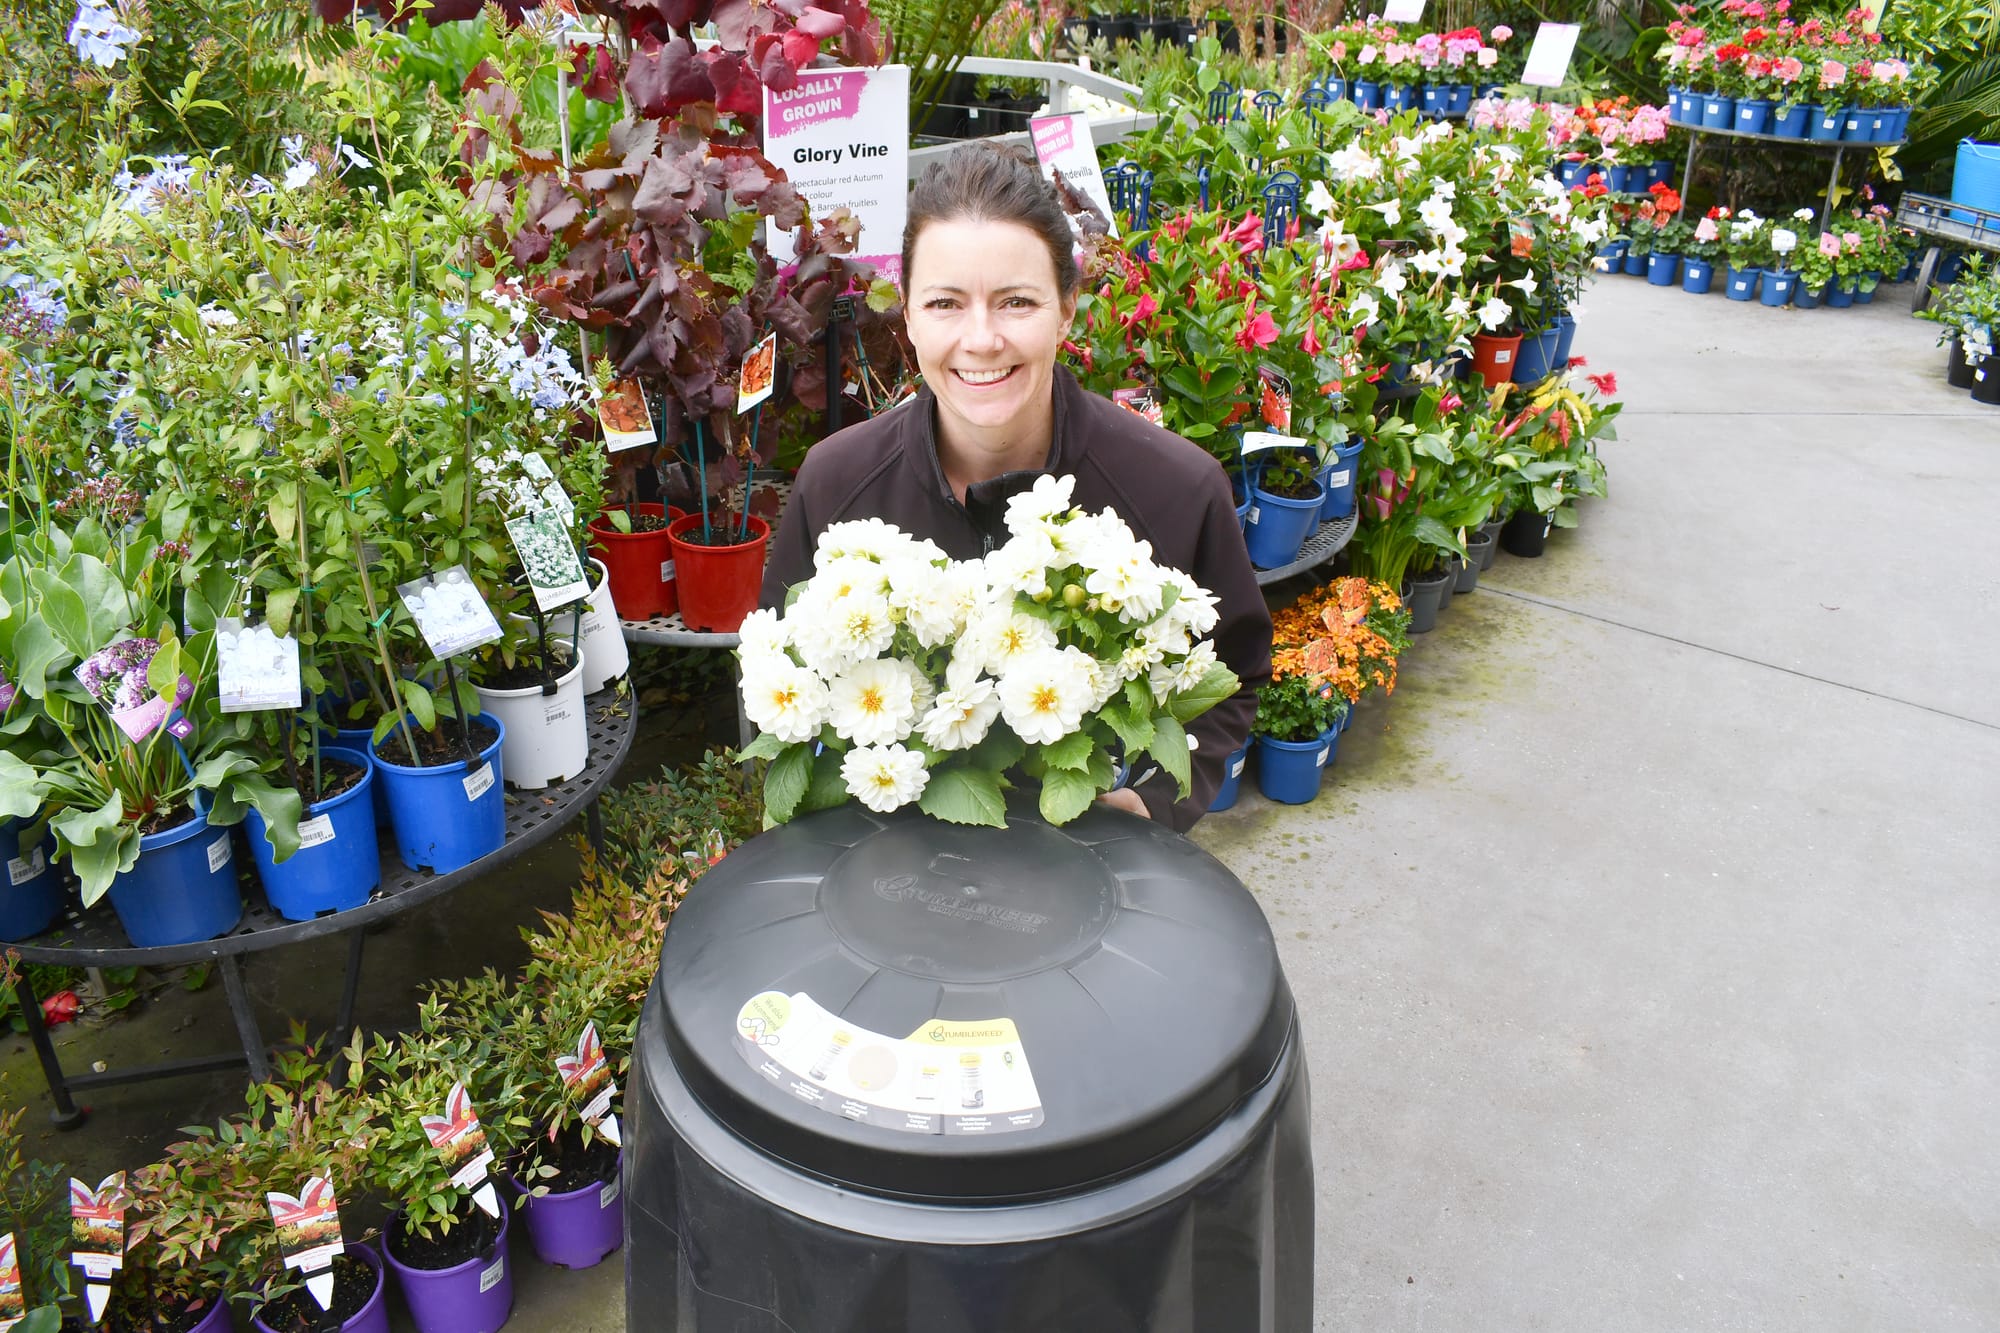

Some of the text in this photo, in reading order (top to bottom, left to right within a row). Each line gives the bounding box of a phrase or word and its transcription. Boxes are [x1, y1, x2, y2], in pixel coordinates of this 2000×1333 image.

[773, 76, 844, 104] LOCALLY
[782, 97, 842, 123] GROWN
[793, 143, 888, 164] Glory Vine
[838, 175, 851, 184] red
[853, 173, 884, 182] Autumn
[809, 191, 833, 199] colour
[818, 202, 846, 212] Barossa
[848, 199, 878, 208] fruitless
